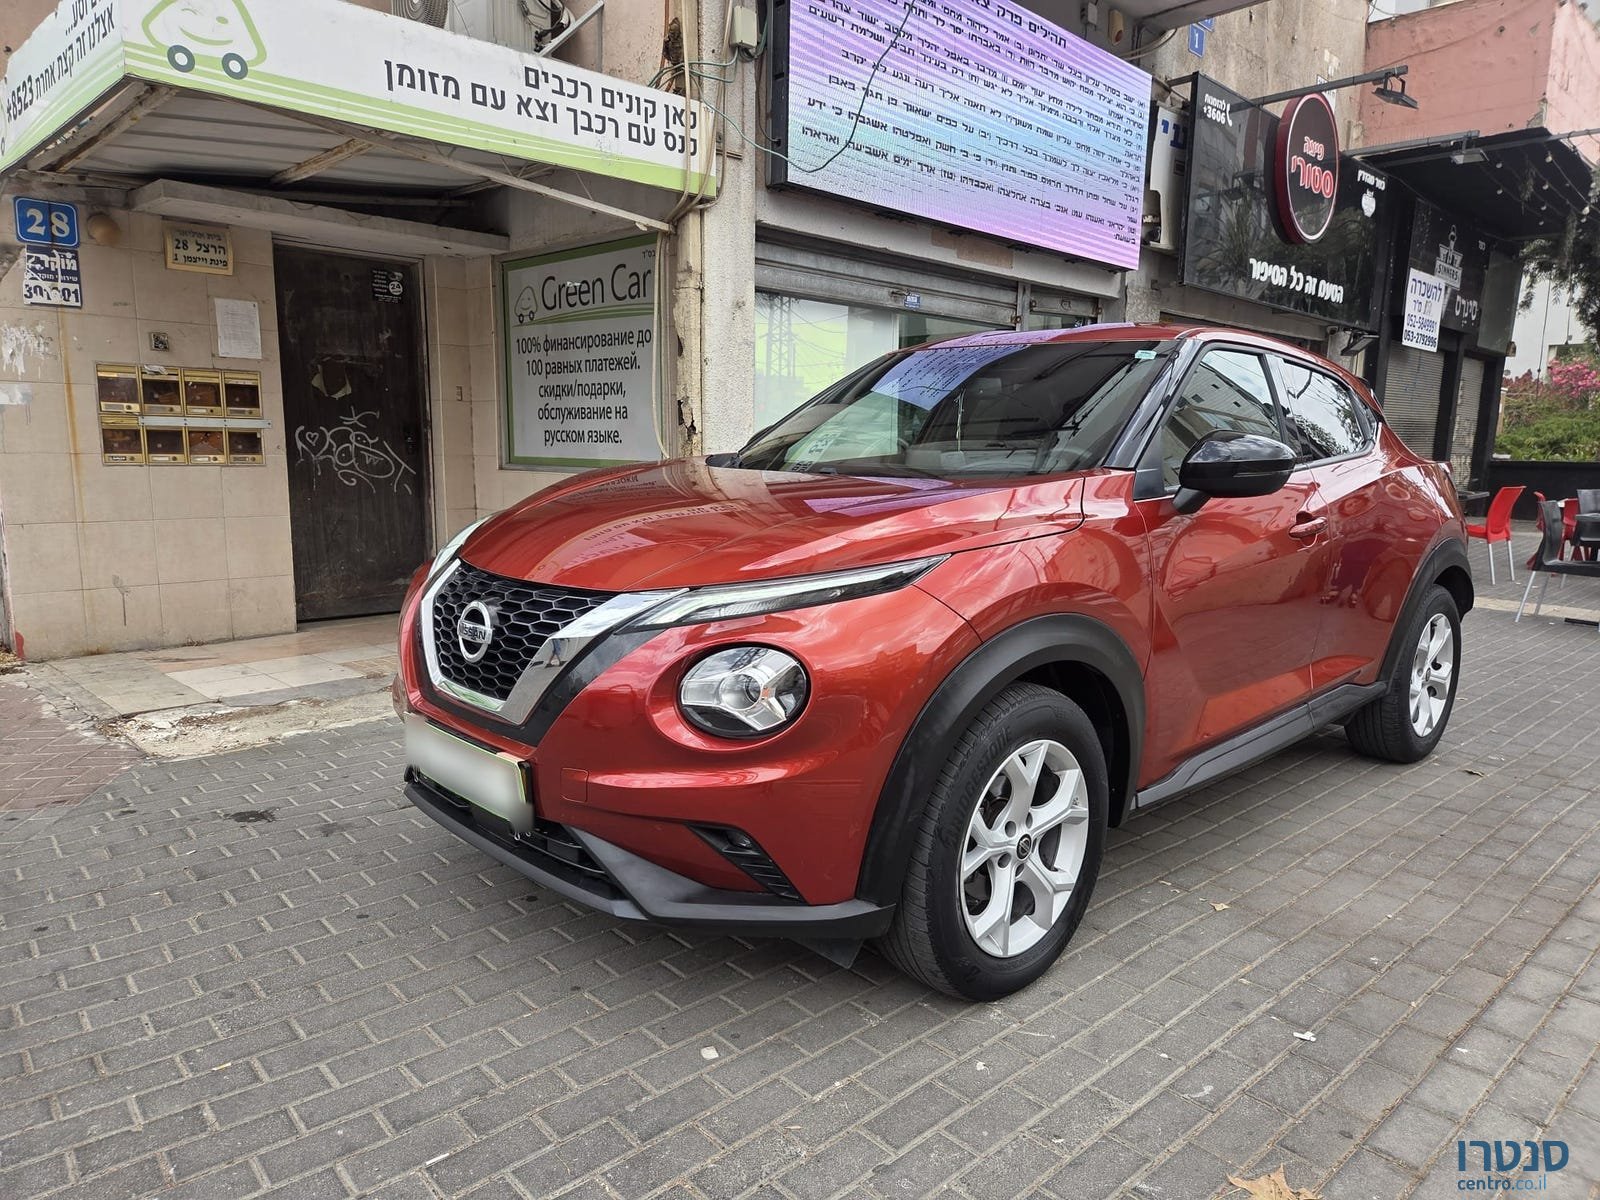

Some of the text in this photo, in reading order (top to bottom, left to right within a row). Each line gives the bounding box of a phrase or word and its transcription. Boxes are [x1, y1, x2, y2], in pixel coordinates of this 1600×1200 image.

[809, 5, 845, 27] רשעים
[932, 15, 945, 27] לך
[941, 5, 962, 20] מחסי
[88, 3, 114, 50] אצלנו
[997, 5, 1067, 48] תהילים פרק
[76, 31, 86, 62] זה
[993, 30, 1010, 44] אמר
[1195, 32, 1198, 48] 1
[57, 44, 73, 78] קצת
[841, 49, 867, 64] יקרב
[36, 61, 56, 100] אחרת
[951, 66, 963, 77] רק
[829, 75, 856, 91] באבן
[915, 79, 934, 92] רעה
[525, 66, 697, 130] כאן קונים רכבים
[887, 96, 897, 106] פן
[939, 87, 960, 101] אליך
[384, 60, 698, 156] כנס עם רכבך וצא עם מזומן
[808, 98, 826, 110] ידע
[832, 105, 842, 115] כי
[990, 107, 1001, 118] לא
[802, 126, 839, 145] ואראהו
[962, 122, 974, 134] על
[1304, 136, 1324, 160] פיצה
[1291, 155, 1333, 198] סטורי
[26, 208, 70, 238] 28
[175, 239, 226, 255] הרצל 28
[1250, 258, 1287, 287] הסיפור
[1289, 265, 1303, 291] כל
[1438, 264, 1458, 281] SINNERS
[541, 264, 651, 310] Green Car
[1305, 276, 1317, 295] זה
[1411, 278, 1442, 302] להשכרה
[516, 329, 651, 356] 100% финансирование до
[1404, 329, 1437, 348] 053-2792996
[527, 351, 640, 378] 100 равных платежей.
[539, 379, 626, 400] скидки/подарки,
[538, 403, 628, 424] обслуживание на
[544, 429, 622, 446] русском языке.
